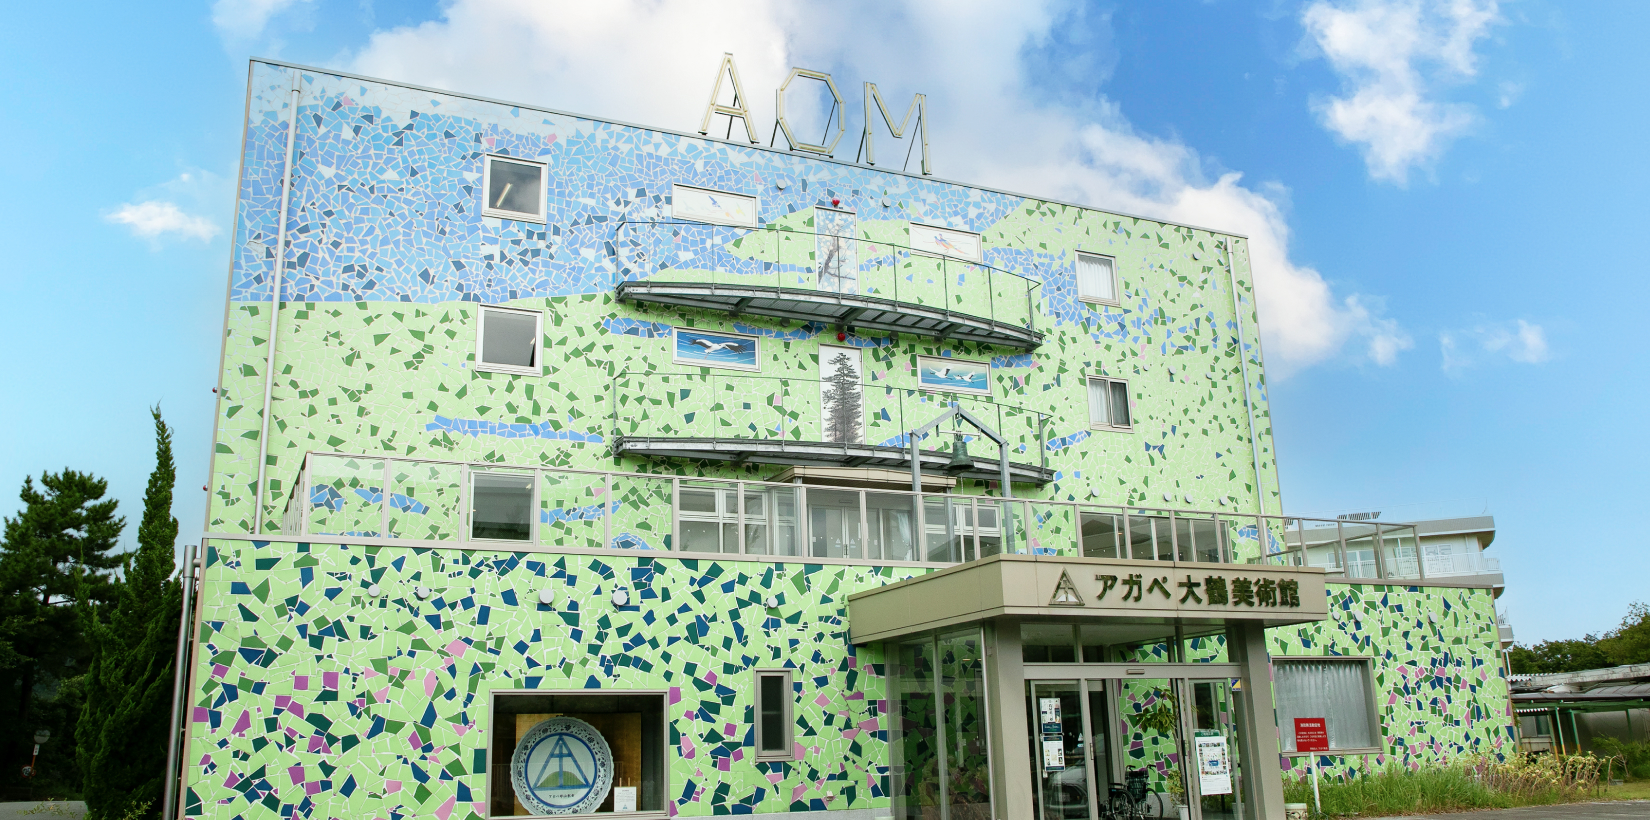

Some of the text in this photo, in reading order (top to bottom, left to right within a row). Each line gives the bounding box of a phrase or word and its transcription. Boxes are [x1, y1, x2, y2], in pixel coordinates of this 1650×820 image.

[698, 51, 932, 175] AOM
[1095, 573, 1300, 608] アガペ大鶴美術館
